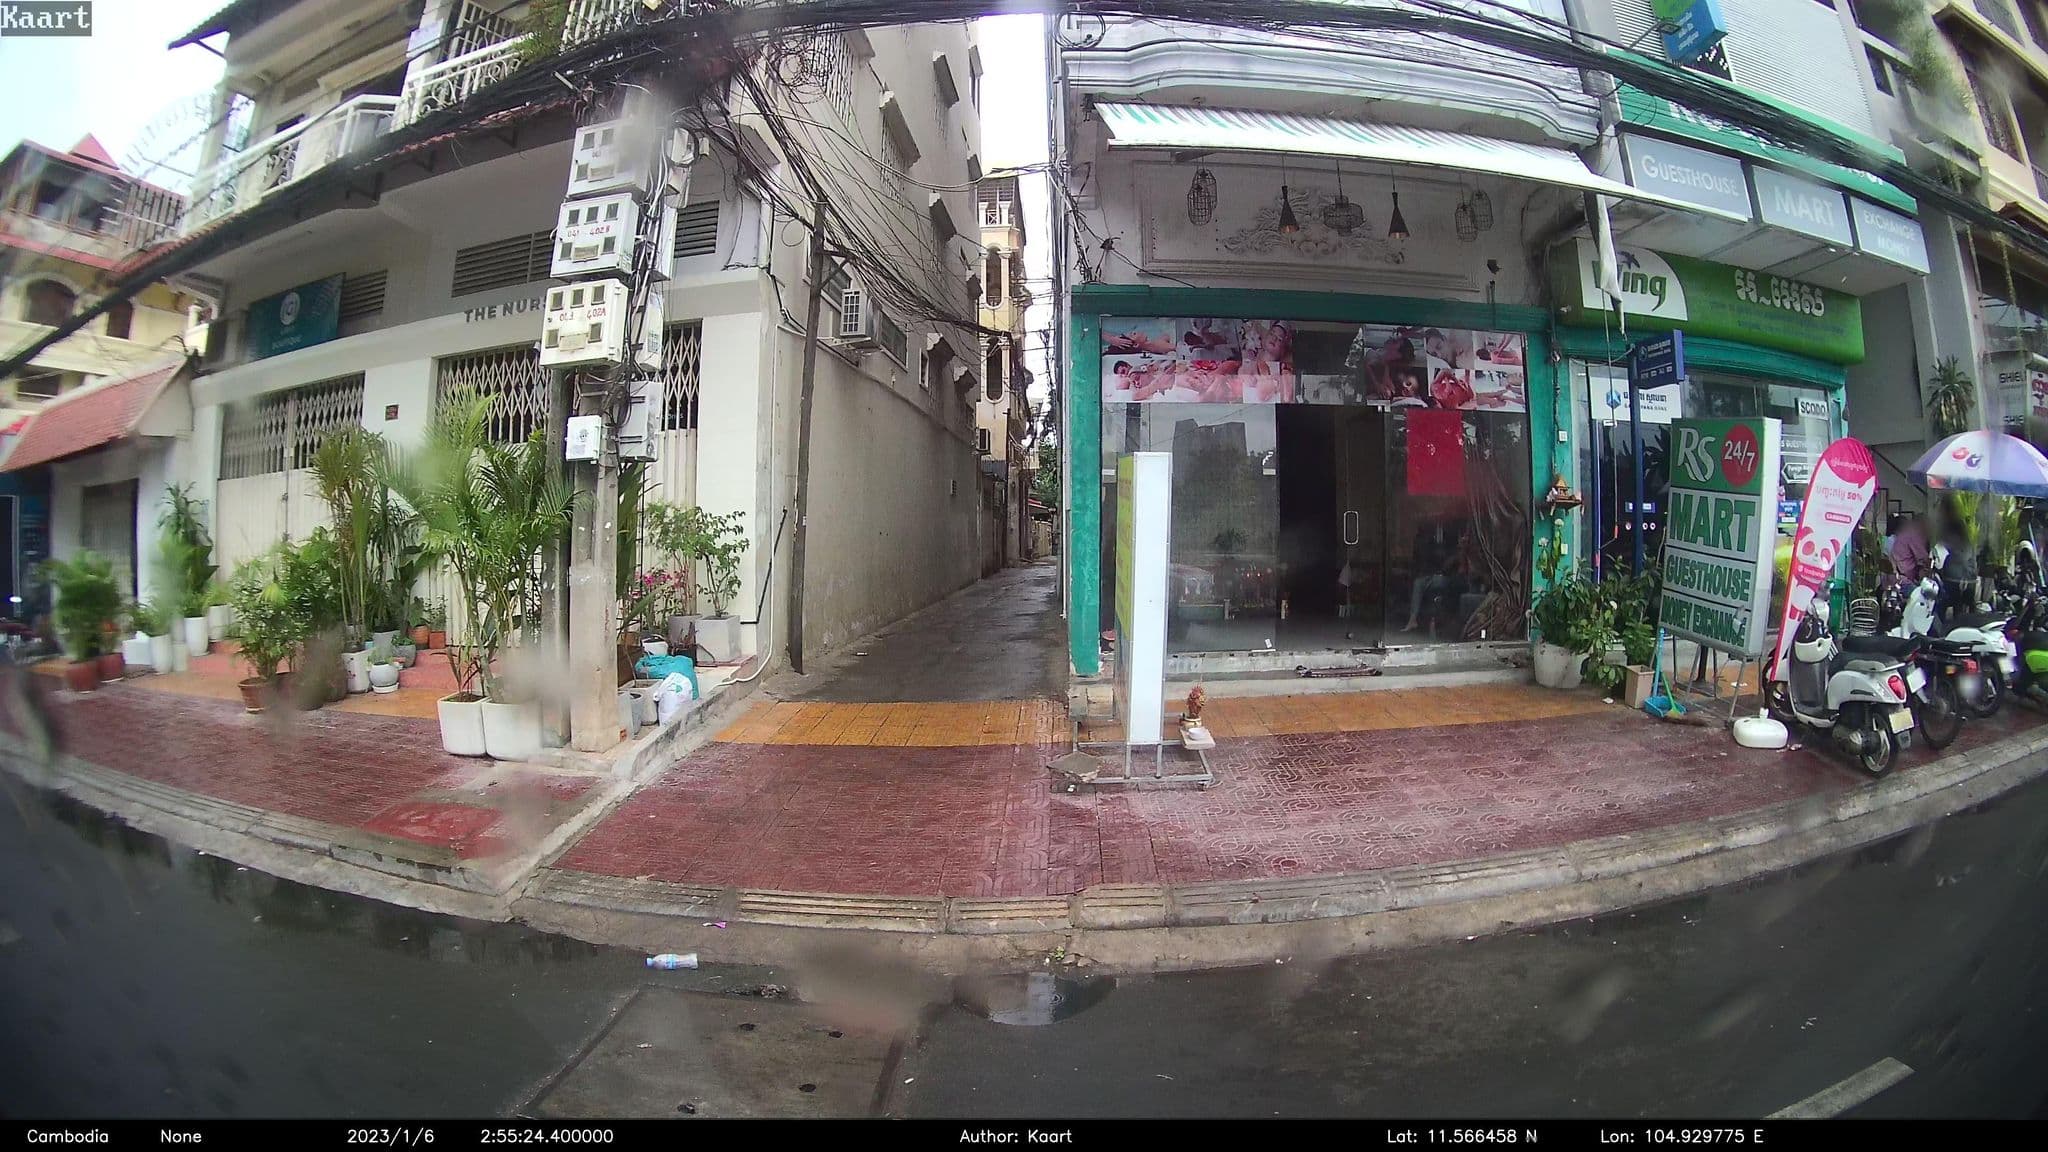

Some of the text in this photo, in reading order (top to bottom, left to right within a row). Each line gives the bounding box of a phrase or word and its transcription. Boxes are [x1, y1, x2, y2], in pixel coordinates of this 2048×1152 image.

[1775, 185, 1834, 227] MART
[464, 296, 547, 323] THE NUR
[1677, 427, 1756, 483] RS 24/7
[1847, 491, 1863, 503] 50%
[1670, 492, 1758, 553] MART
[1666, 554, 1752, 601] GUESTHOUSE
[1661, 594, 1693, 632] MONEY
